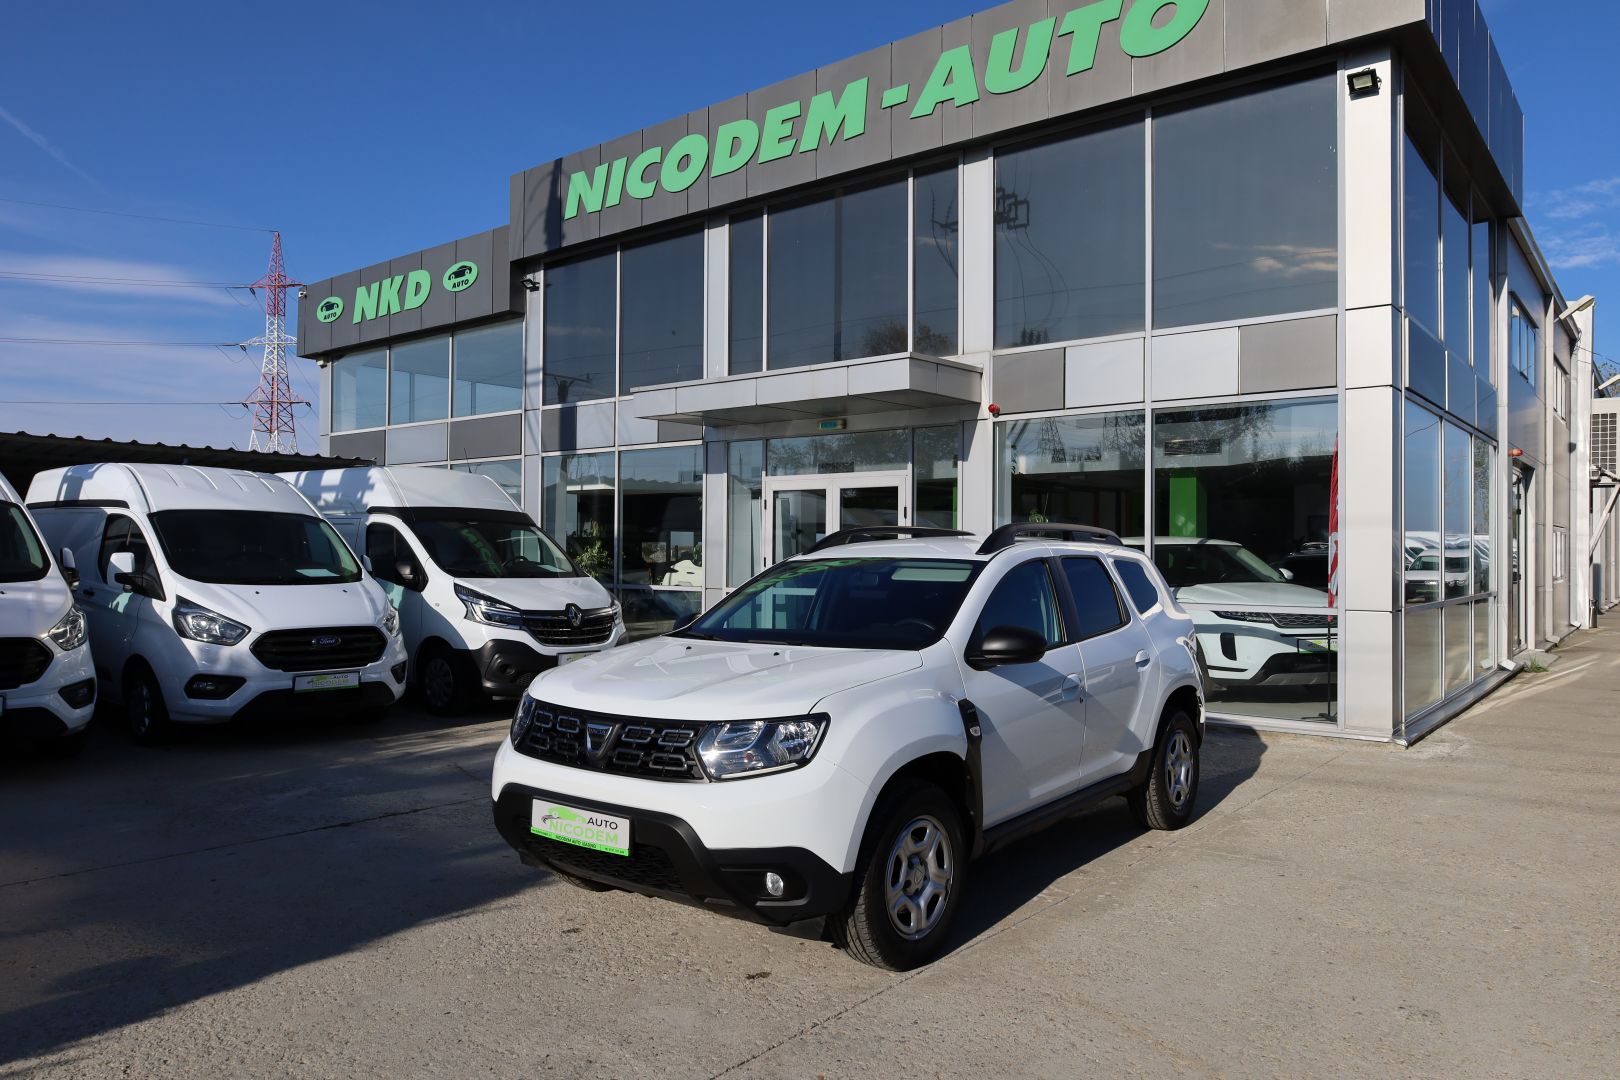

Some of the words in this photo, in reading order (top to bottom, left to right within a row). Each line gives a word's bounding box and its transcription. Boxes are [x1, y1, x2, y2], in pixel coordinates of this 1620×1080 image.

[564, 77, 868, 220] NICODEM
[910, 0, 1210, 118] AUTO
[451, 278, 469, 289] AUTO
[352, 269, 432, 324] NKD
[323, 312, 337, 320] AUTO
[549, 820, 619, 845] NICODEM
[587, 817, 618, 830] AUTO
